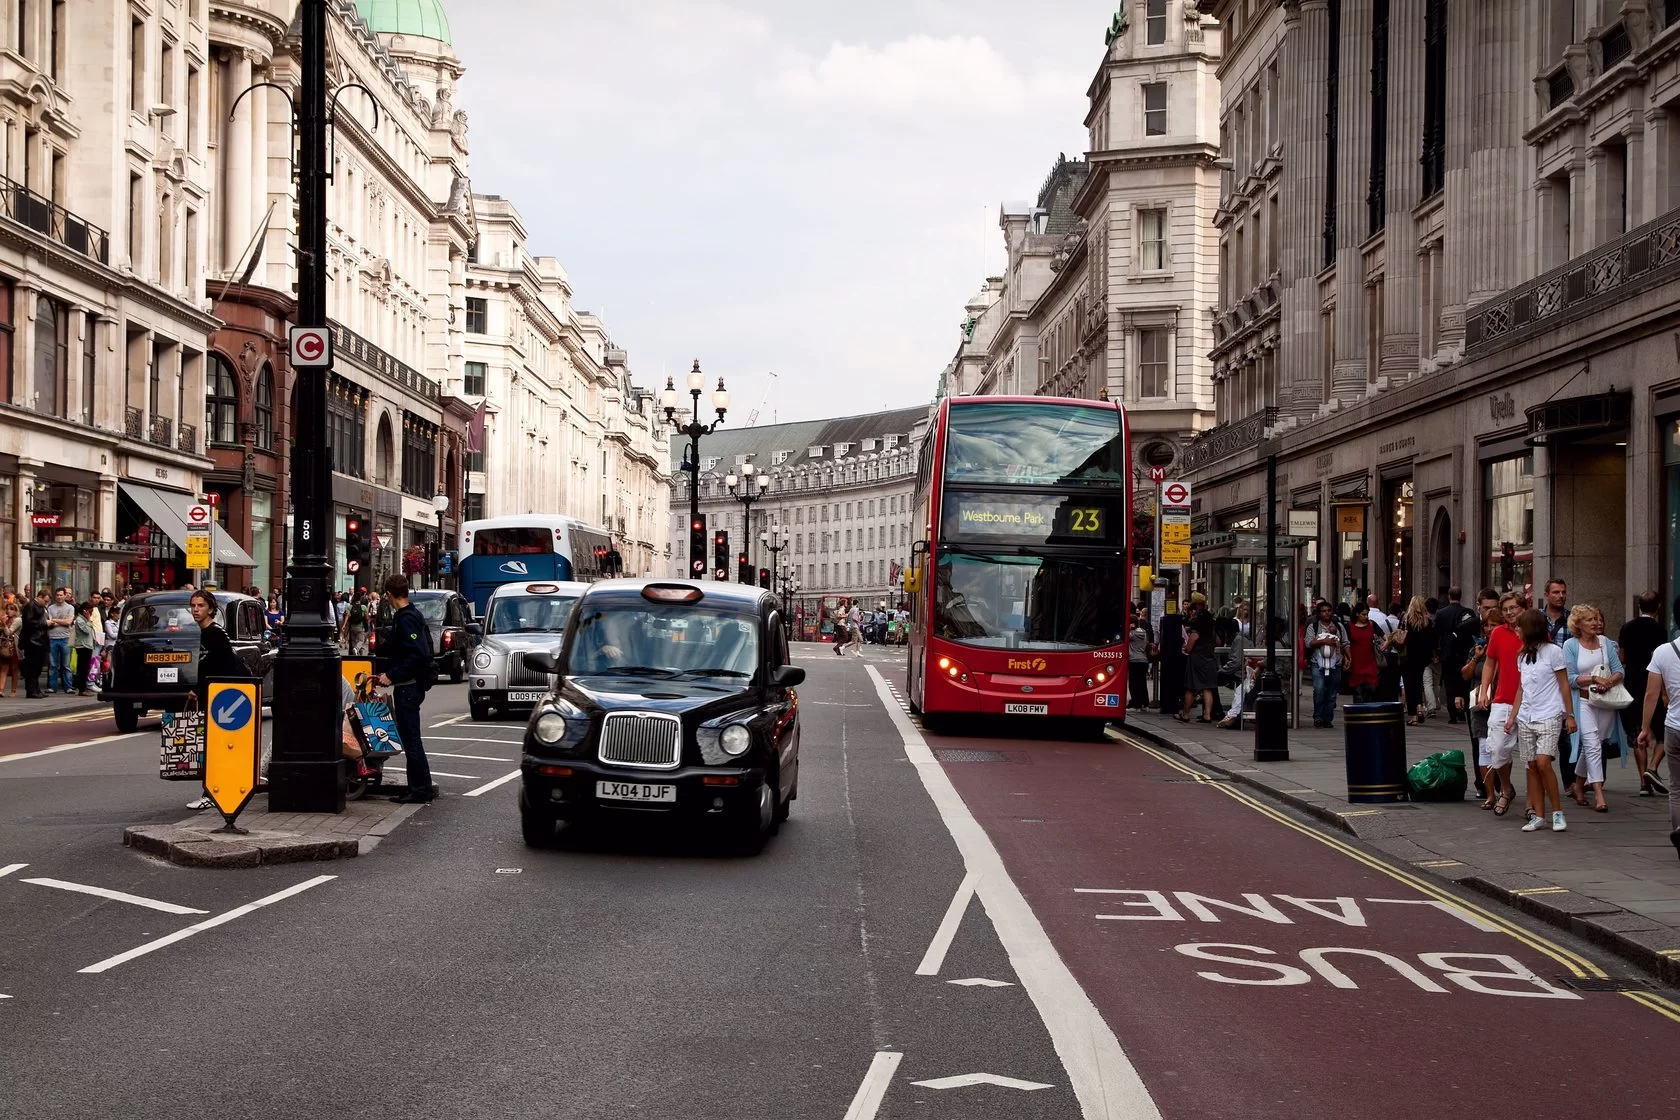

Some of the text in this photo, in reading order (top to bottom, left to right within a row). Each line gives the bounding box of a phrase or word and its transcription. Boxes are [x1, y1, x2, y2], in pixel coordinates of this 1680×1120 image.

[299, 335, 321, 358] C
[1152, 468, 1164, 479] M
[209, 494, 218, 504] T
[962, 510, 1044, 525] Westbourne Park
[1071, 509, 1100, 531] 23
[1093, 651, 1123, 659] DN33513
[1008, 659, 1032, 670] First
[1007, 704, 1045, 713] LK08 FMV
[602, 782, 670, 799] LX04 DJF
[1074, 888, 1500, 932] LANE
[1173, 943, 1584, 1000] BUS
